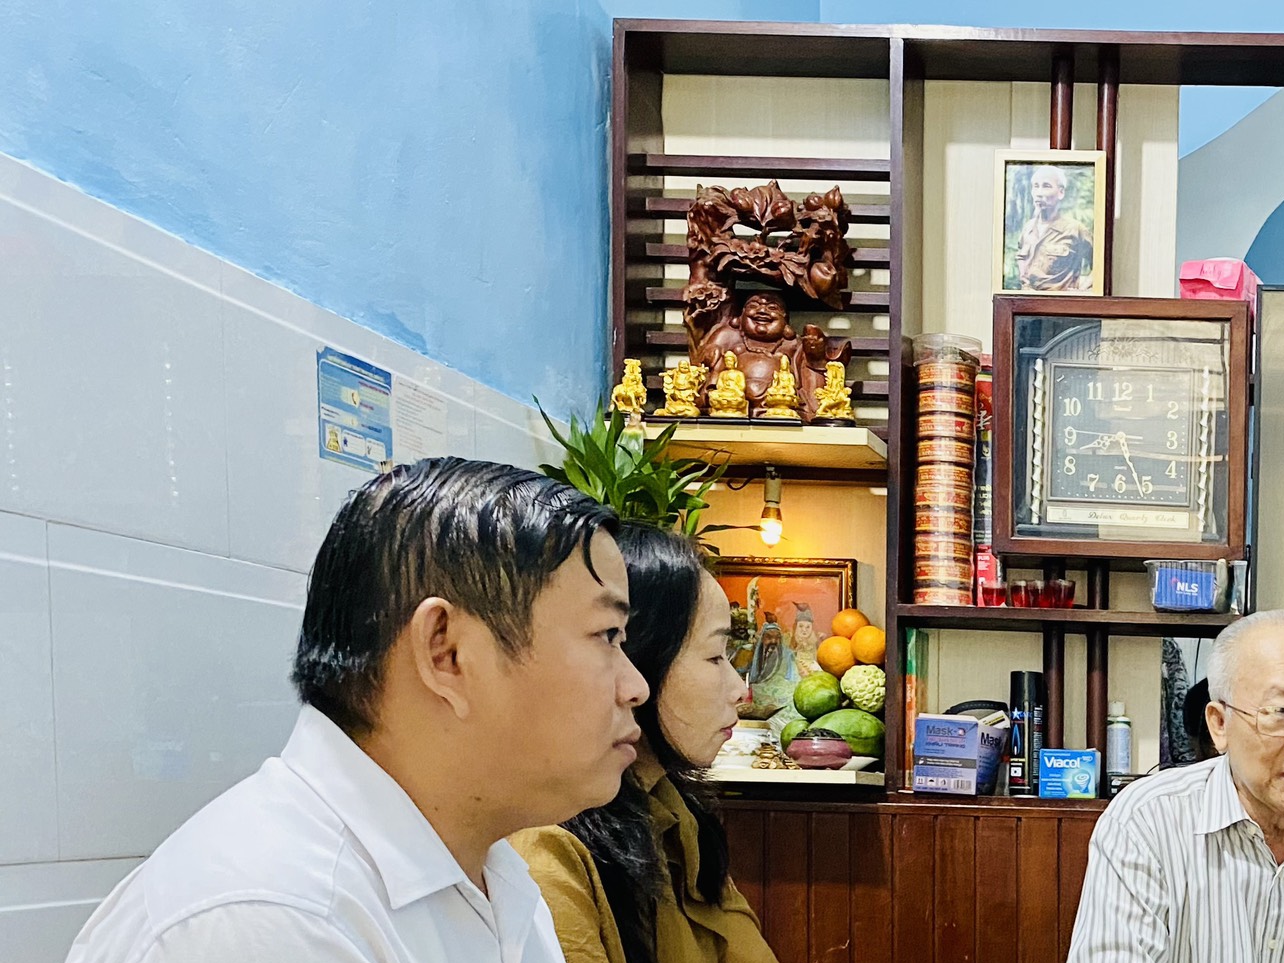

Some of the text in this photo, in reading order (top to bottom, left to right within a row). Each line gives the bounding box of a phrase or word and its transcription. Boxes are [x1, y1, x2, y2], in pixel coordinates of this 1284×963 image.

[1087, 382, 1104, 400] 11
[1112, 382, 1133, 401] 12
[1146, 384, 1155, 402] 1
[1063, 398, 1081, 417] 10
[1167, 401, 1179, 419] 2
[1064, 426, 1077, 446] 9
[1166, 431, 1178, 450] 3
[1063, 456, 1076, 476] 8
[1165, 461, 1177, 479] 4
[1087, 474, 1099, 492] 7
[1114, 474, 1126, 494] 6
[1141, 476, 1153, 494] 5
[1177, 581, 1199, 593] NLS
[1044, 756, 1081, 769] Viacol
